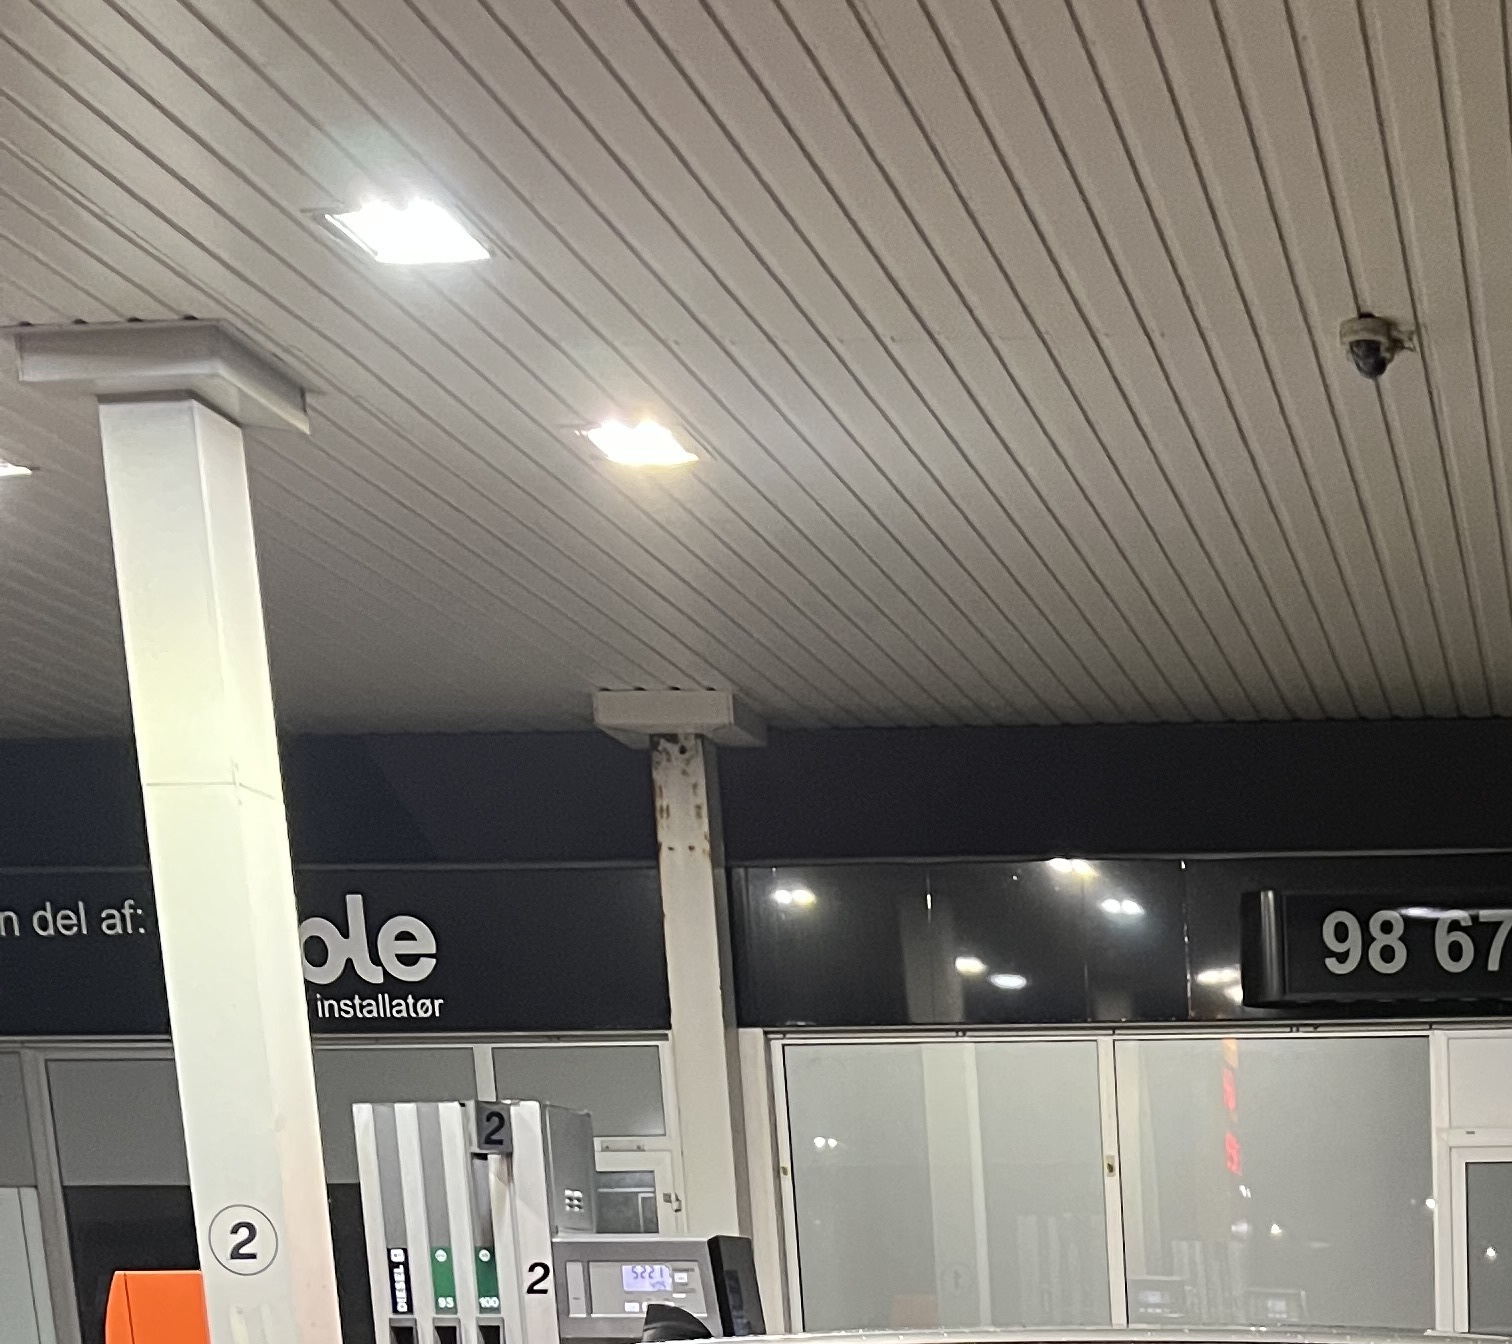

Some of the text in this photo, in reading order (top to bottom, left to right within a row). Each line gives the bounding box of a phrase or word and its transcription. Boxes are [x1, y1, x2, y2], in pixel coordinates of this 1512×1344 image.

[33, 901, 87, 936] del
[100, 899, 145, 936] af:
[1322, 910, 1407, 975] 98
[317, 993, 444, 1019] installatør
[484, 1111, 506, 1146] 2
[229, 1221, 258, 1261] 2
[393, 1264, 408, 1312] DIESEL
[526, 1262, 551, 1295] 2
[437, 1296, 454, 1308] 95
[479, 1296, 499, 1308] 100
